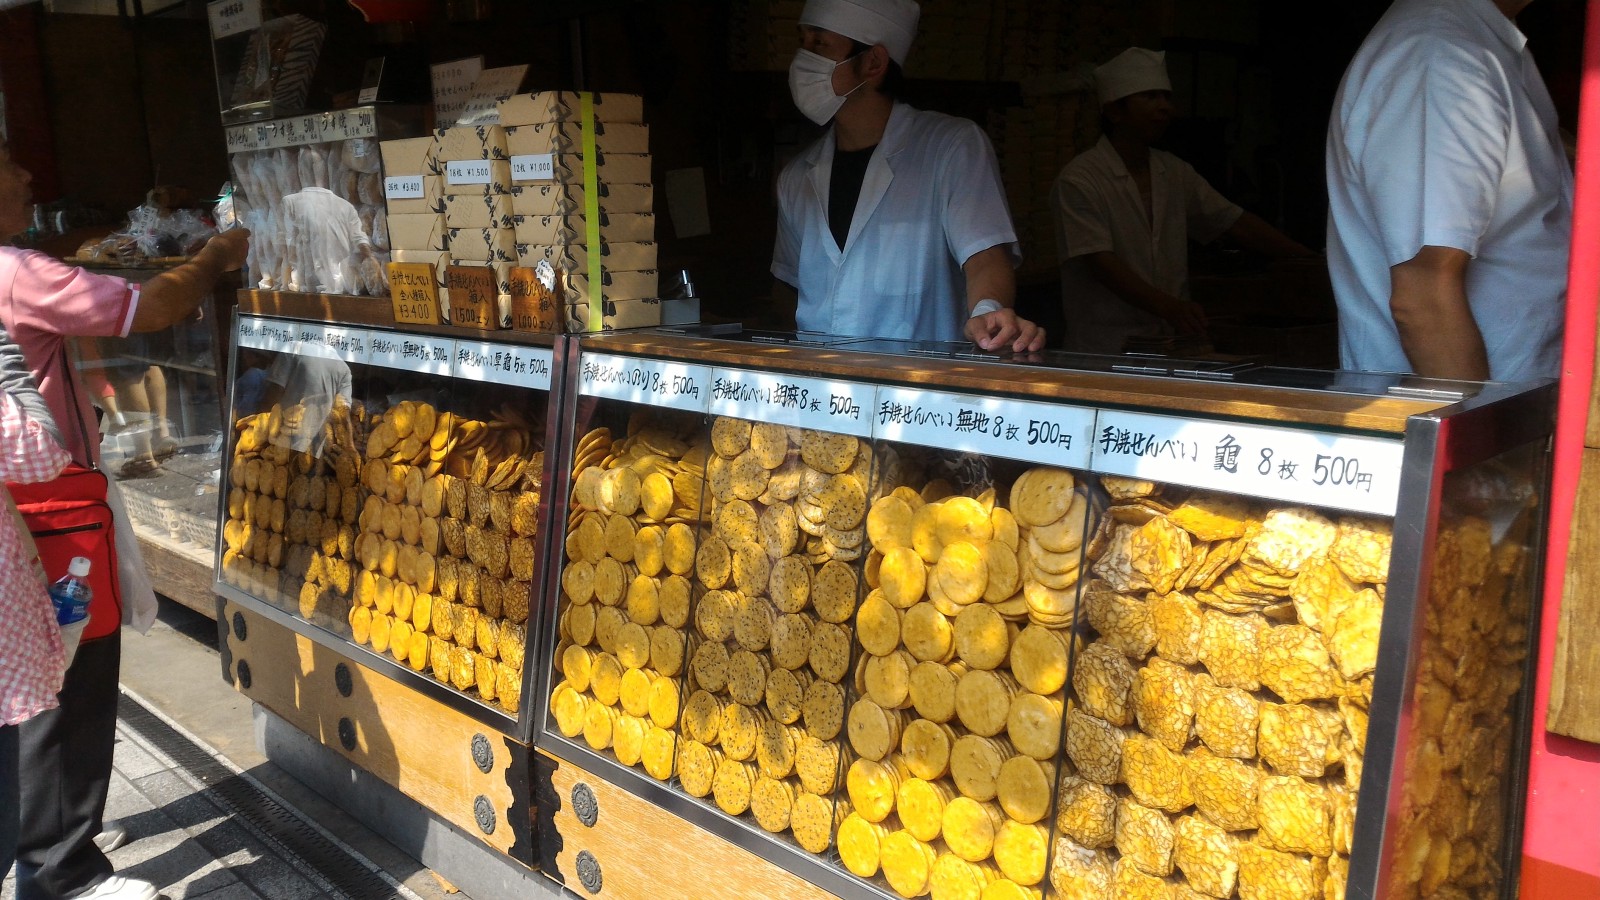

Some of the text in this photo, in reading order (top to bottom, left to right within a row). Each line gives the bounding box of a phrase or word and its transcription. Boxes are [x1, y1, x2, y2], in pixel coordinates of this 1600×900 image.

[449, 167, 489, 177] 18枚 ¥1,500
[513, 162, 551, 173] 12枚 ¥1,000
[529, 358, 549, 379] 500円
[672, 374, 699, 400] 500円
[829, 393, 860, 420] 500円
[1027, 419, 1072, 451] 500円
[1311, 453, 1373, 493] 500円
